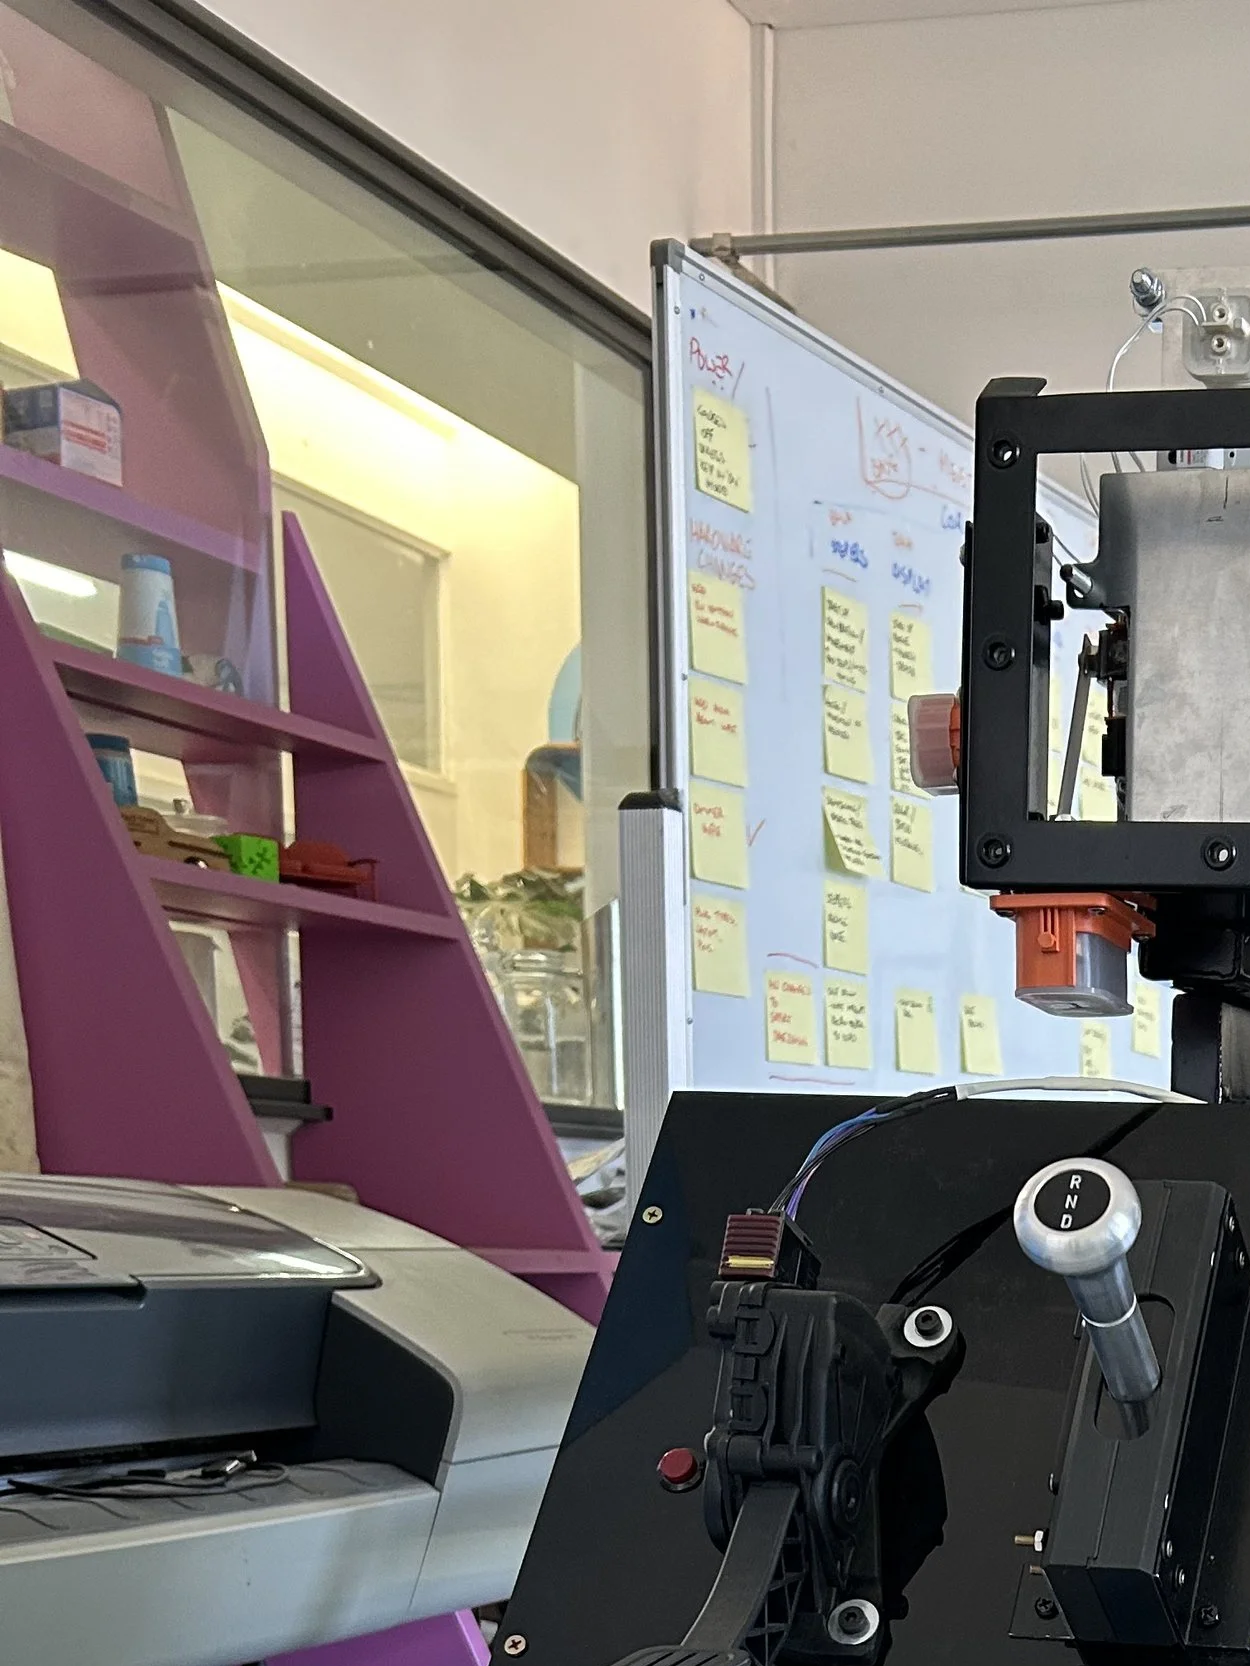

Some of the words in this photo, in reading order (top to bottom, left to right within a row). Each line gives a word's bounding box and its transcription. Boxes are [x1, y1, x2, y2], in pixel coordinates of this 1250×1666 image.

[1069, 1174, 1082, 1190] R
[1064, 1194, 1078, 1210] N
[1060, 1213, 1073, 1229] D
